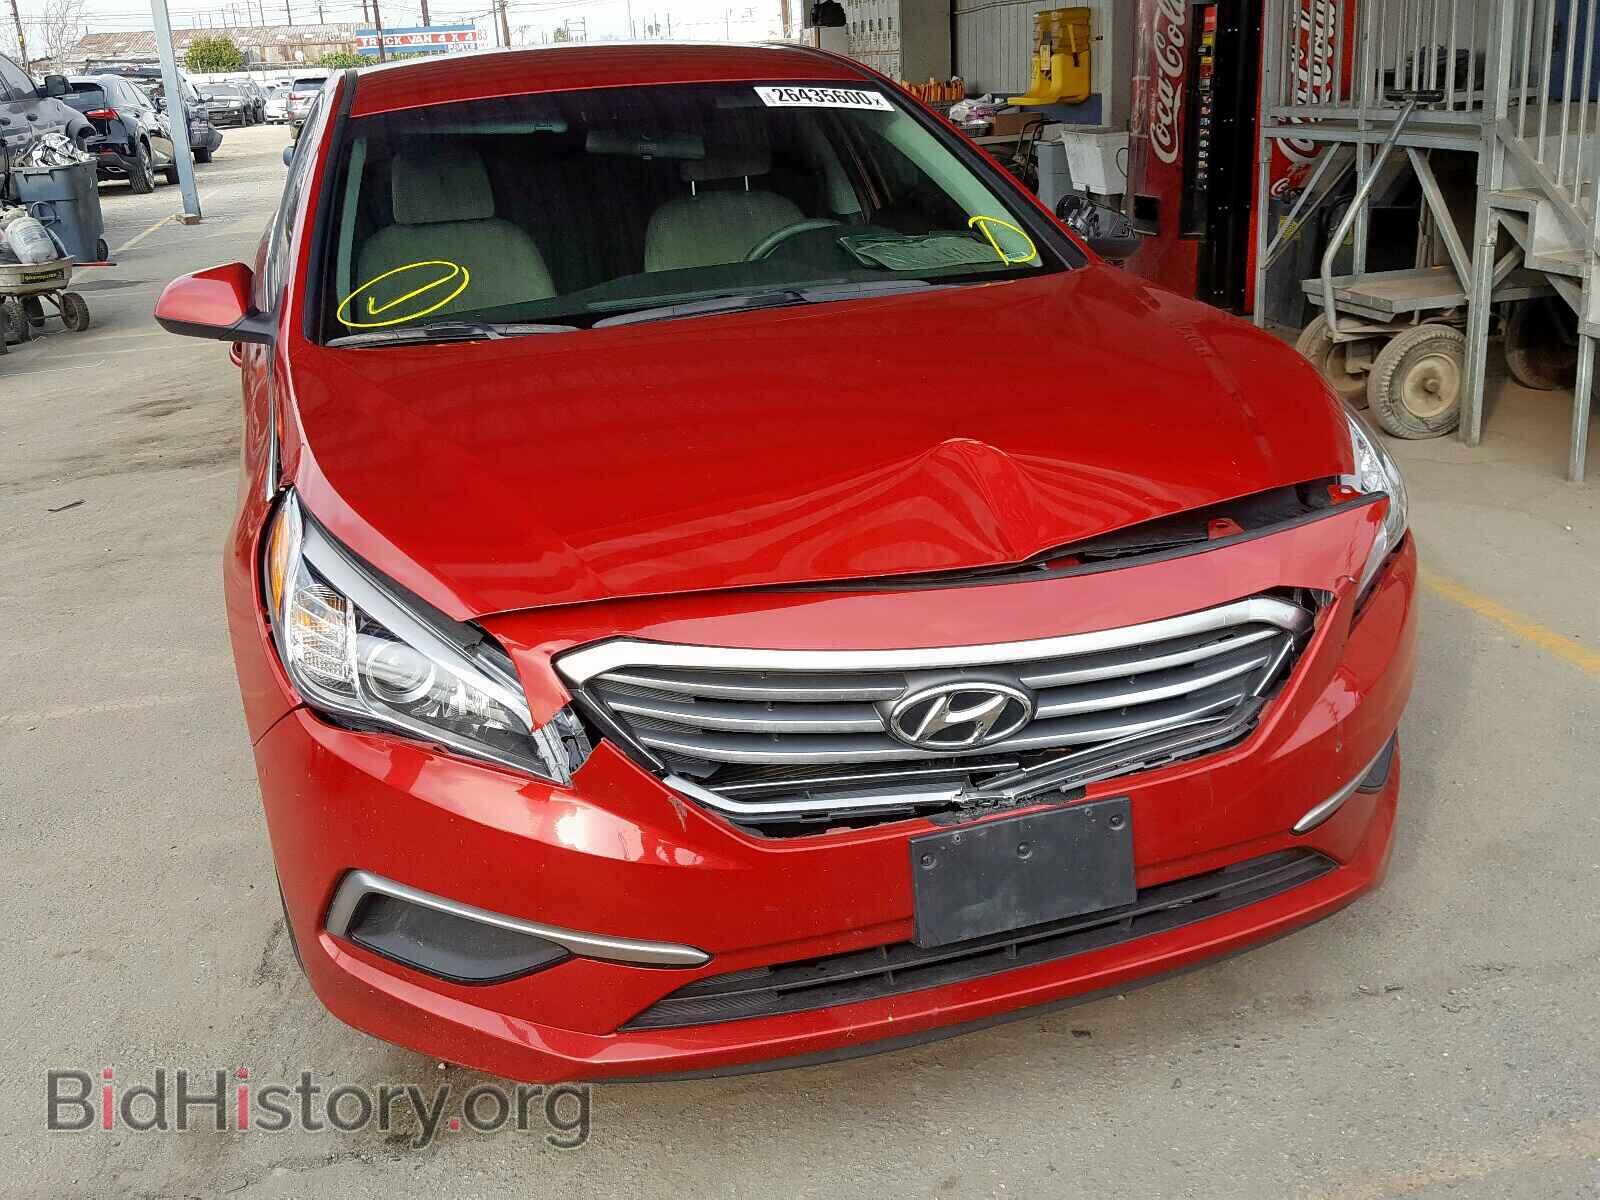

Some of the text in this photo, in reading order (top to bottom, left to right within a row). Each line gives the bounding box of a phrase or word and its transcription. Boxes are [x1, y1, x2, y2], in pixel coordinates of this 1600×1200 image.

[407, 34, 432, 45] VAN
[438, 33, 446, 42] 4
[450, 32, 460, 42] X
[465, 31, 474, 41] 4
[771, 88, 873, 106] 26435600
